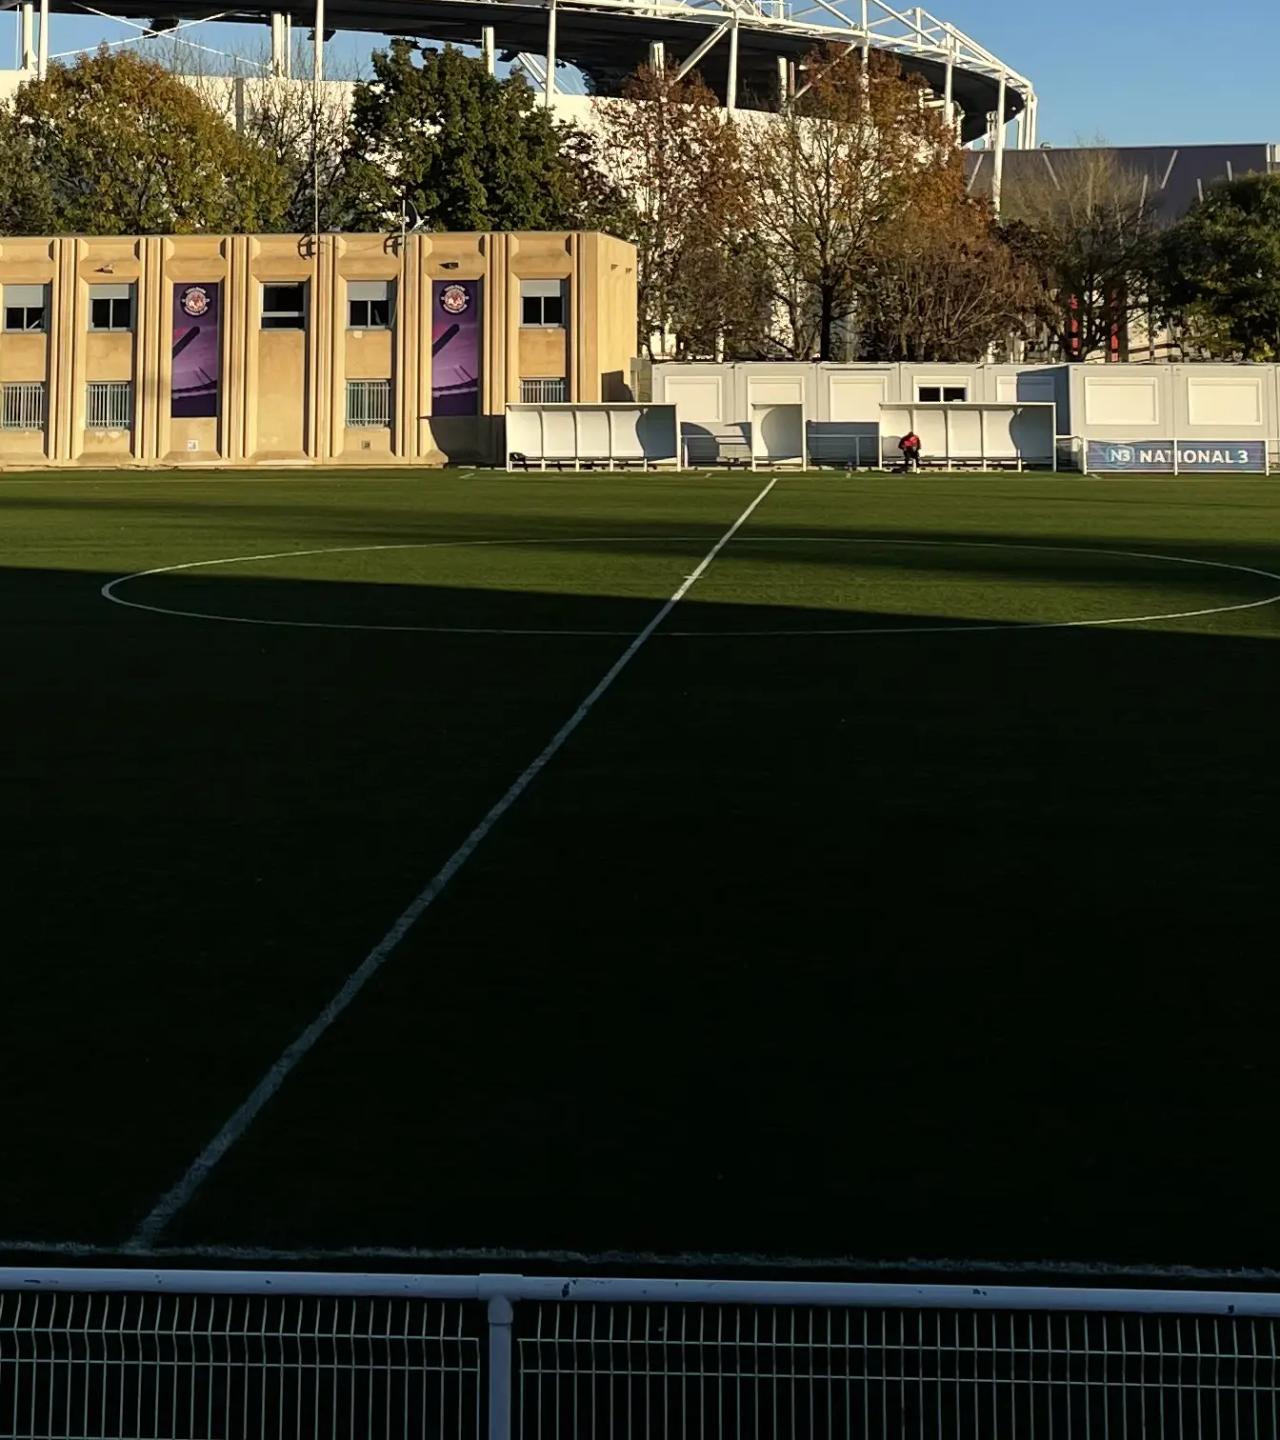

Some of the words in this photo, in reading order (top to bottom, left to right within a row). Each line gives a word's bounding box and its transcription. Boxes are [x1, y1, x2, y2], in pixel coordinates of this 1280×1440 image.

[1110, 449, 1131, 462] N3
[1140, 449, 1234, 464] NATIONAL
[1238, 449, 1249, 464] 3
